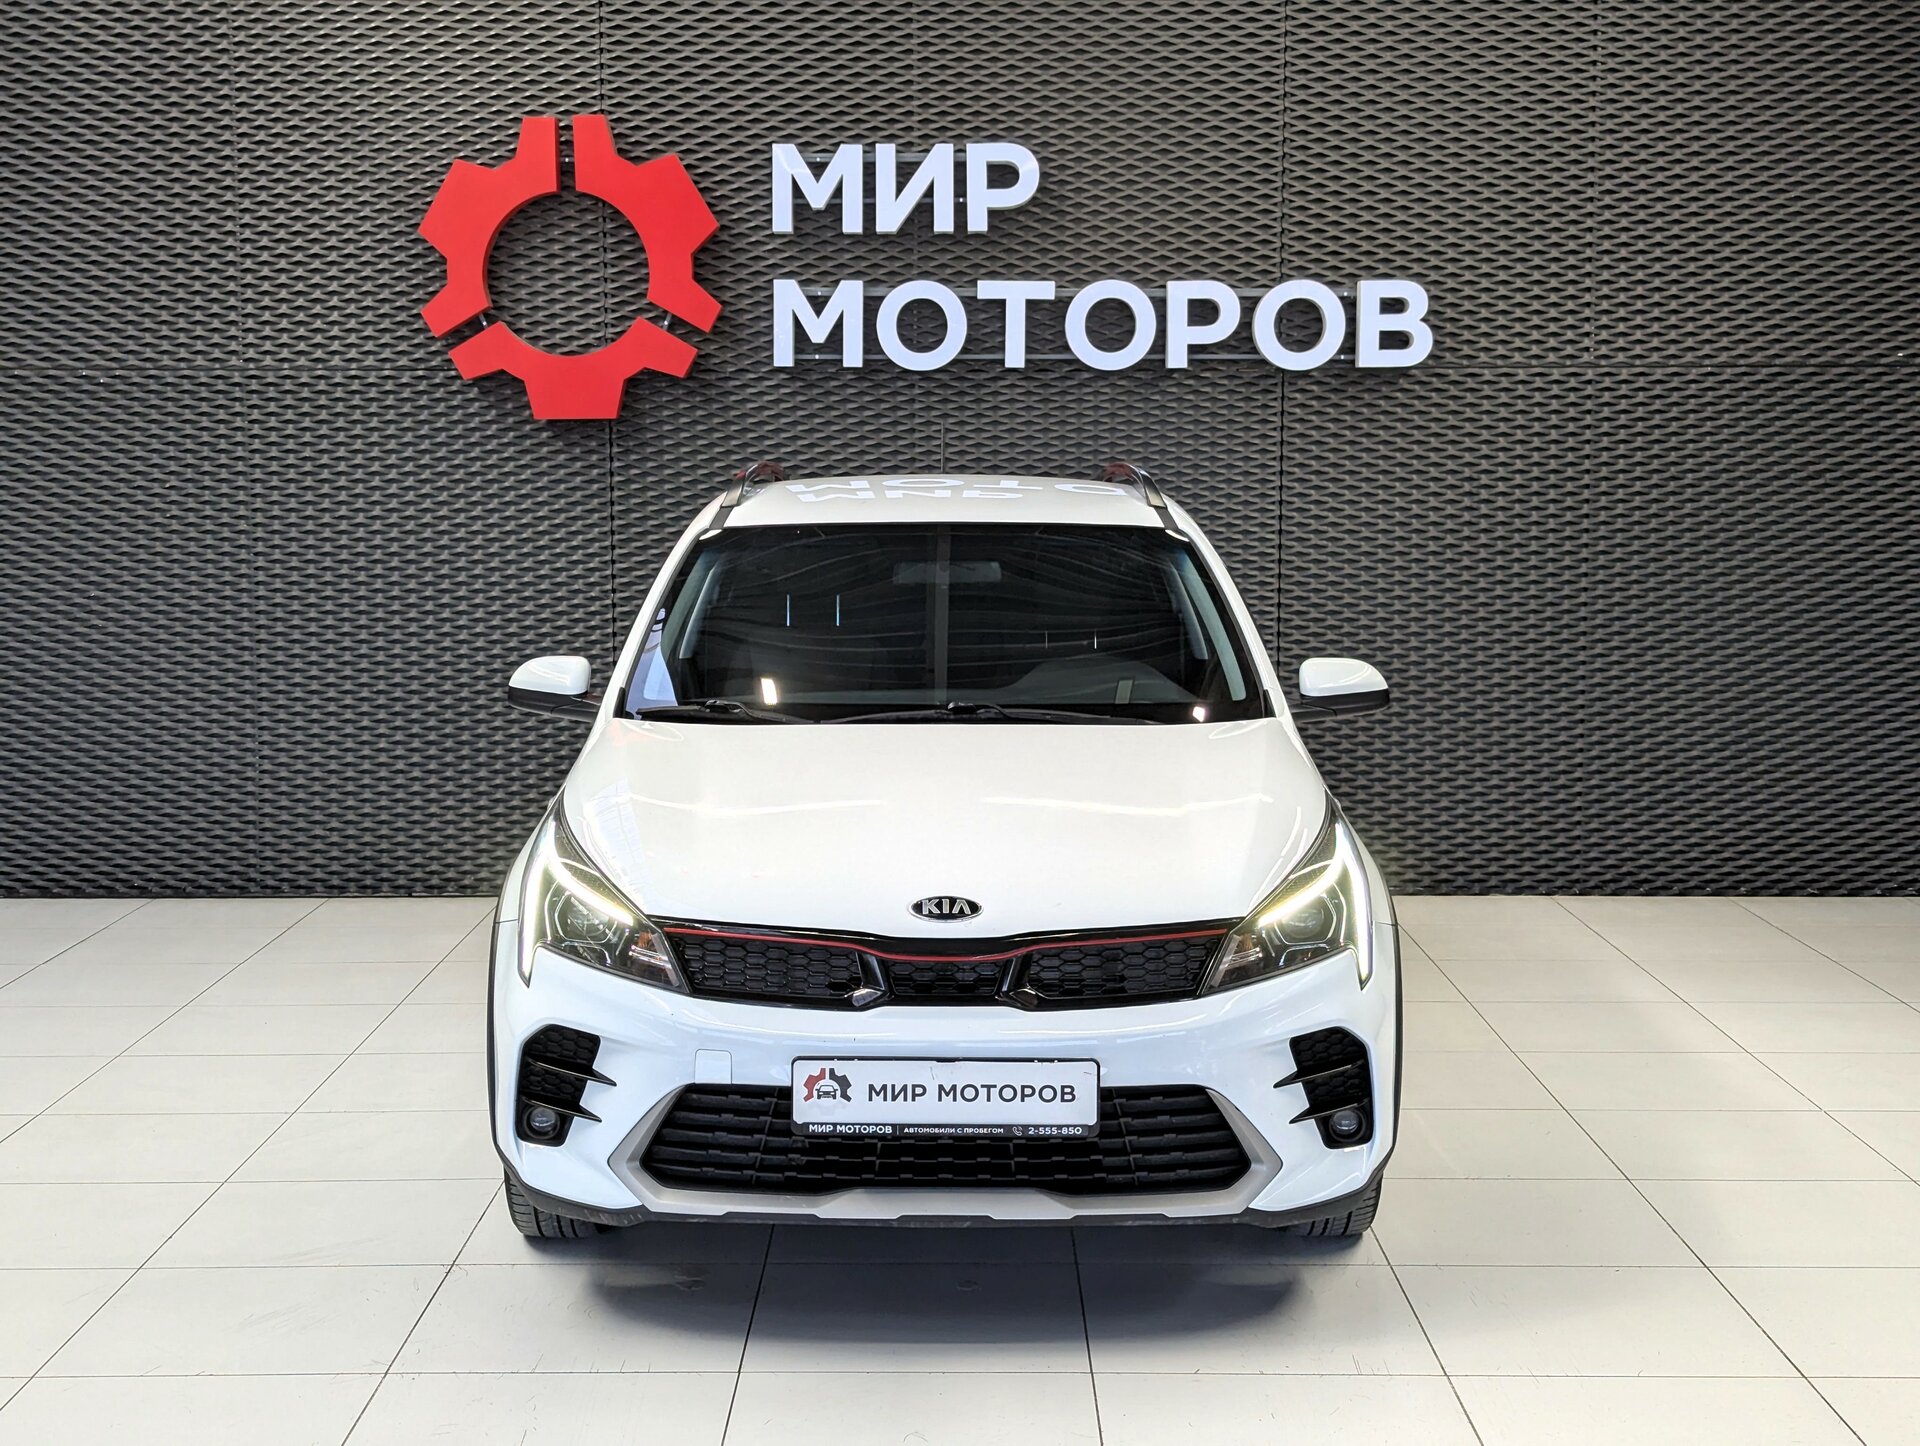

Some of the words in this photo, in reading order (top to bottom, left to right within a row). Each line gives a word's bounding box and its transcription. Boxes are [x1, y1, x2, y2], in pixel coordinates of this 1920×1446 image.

[772, 143, 1040, 235] МИР
[772, 279, 1433, 371] МОТОРОВ
[921, 898, 972, 915] KIA
[868, 1084, 927, 1103] МИР
[937, 1084, 1077, 1103] МОТОРОВ
[808, 1124, 834, 1133] МИР
[836, 1124, 893, 1134] МОТОРОВ
[1028, 1126, 1083, 1135] 2-555-850
